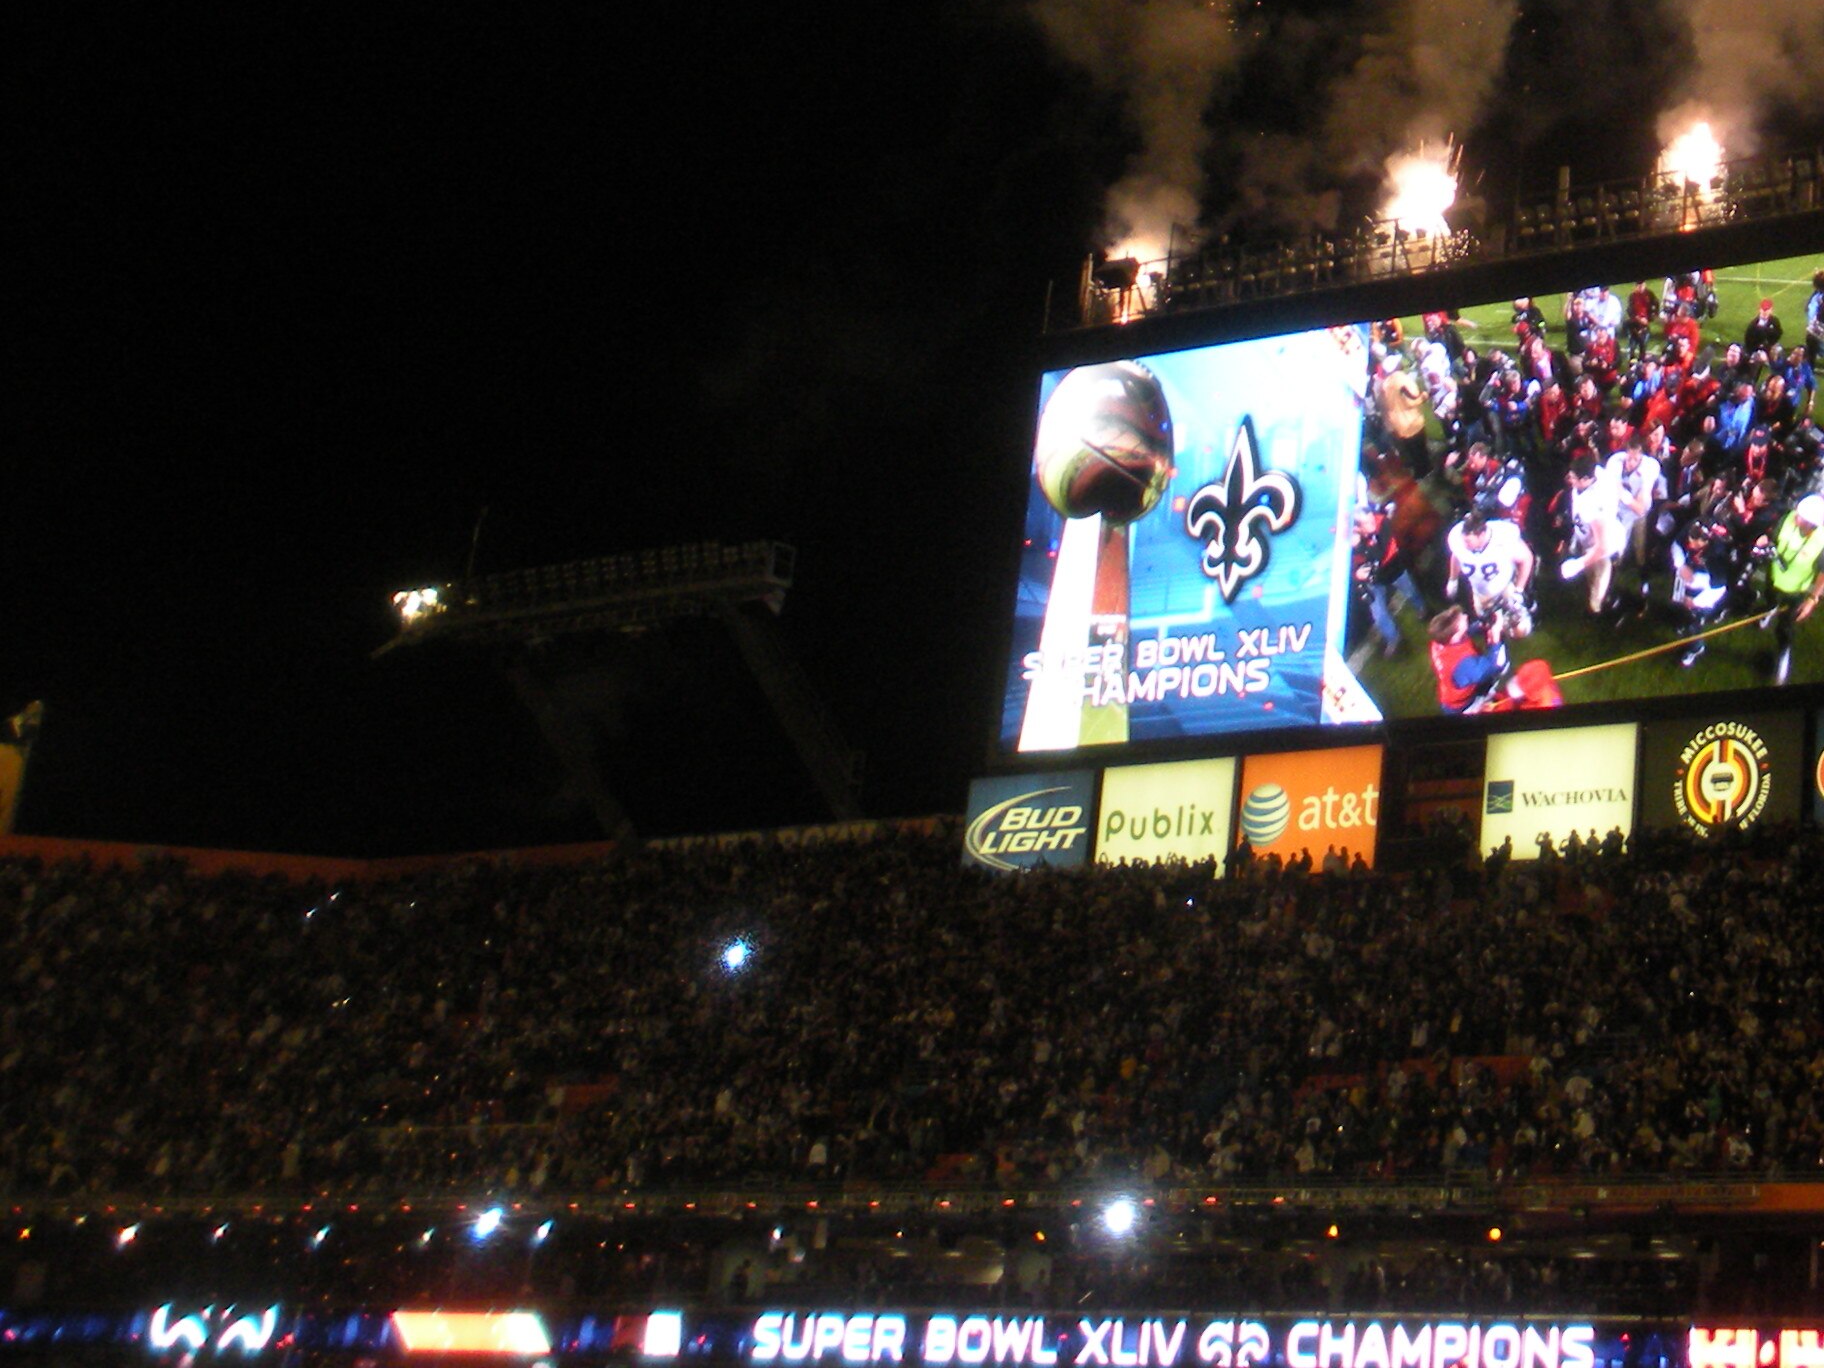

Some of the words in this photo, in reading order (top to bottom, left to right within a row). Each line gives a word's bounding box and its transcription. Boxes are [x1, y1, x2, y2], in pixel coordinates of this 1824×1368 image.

[1136, 633, 1225, 669] BOWL
[1236, 623, 1312, 659] XLIV
[1680, 721, 1769, 765] MICCOSUKEE
[999, 805, 1083, 831] BUD
[1298, 783, 1380, 831] at&t
[1521, 788, 1628, 808] WACHOVIA
[980, 827, 1086, 854] LIGHT
[751, 1312, 907, 1362] SUPER
[922, 1313, 1058, 1363] BOWL
[1073, 1316, 1187, 1366] XLIV
[1286, 1320, 1596, 1368] CHAMPIONS
